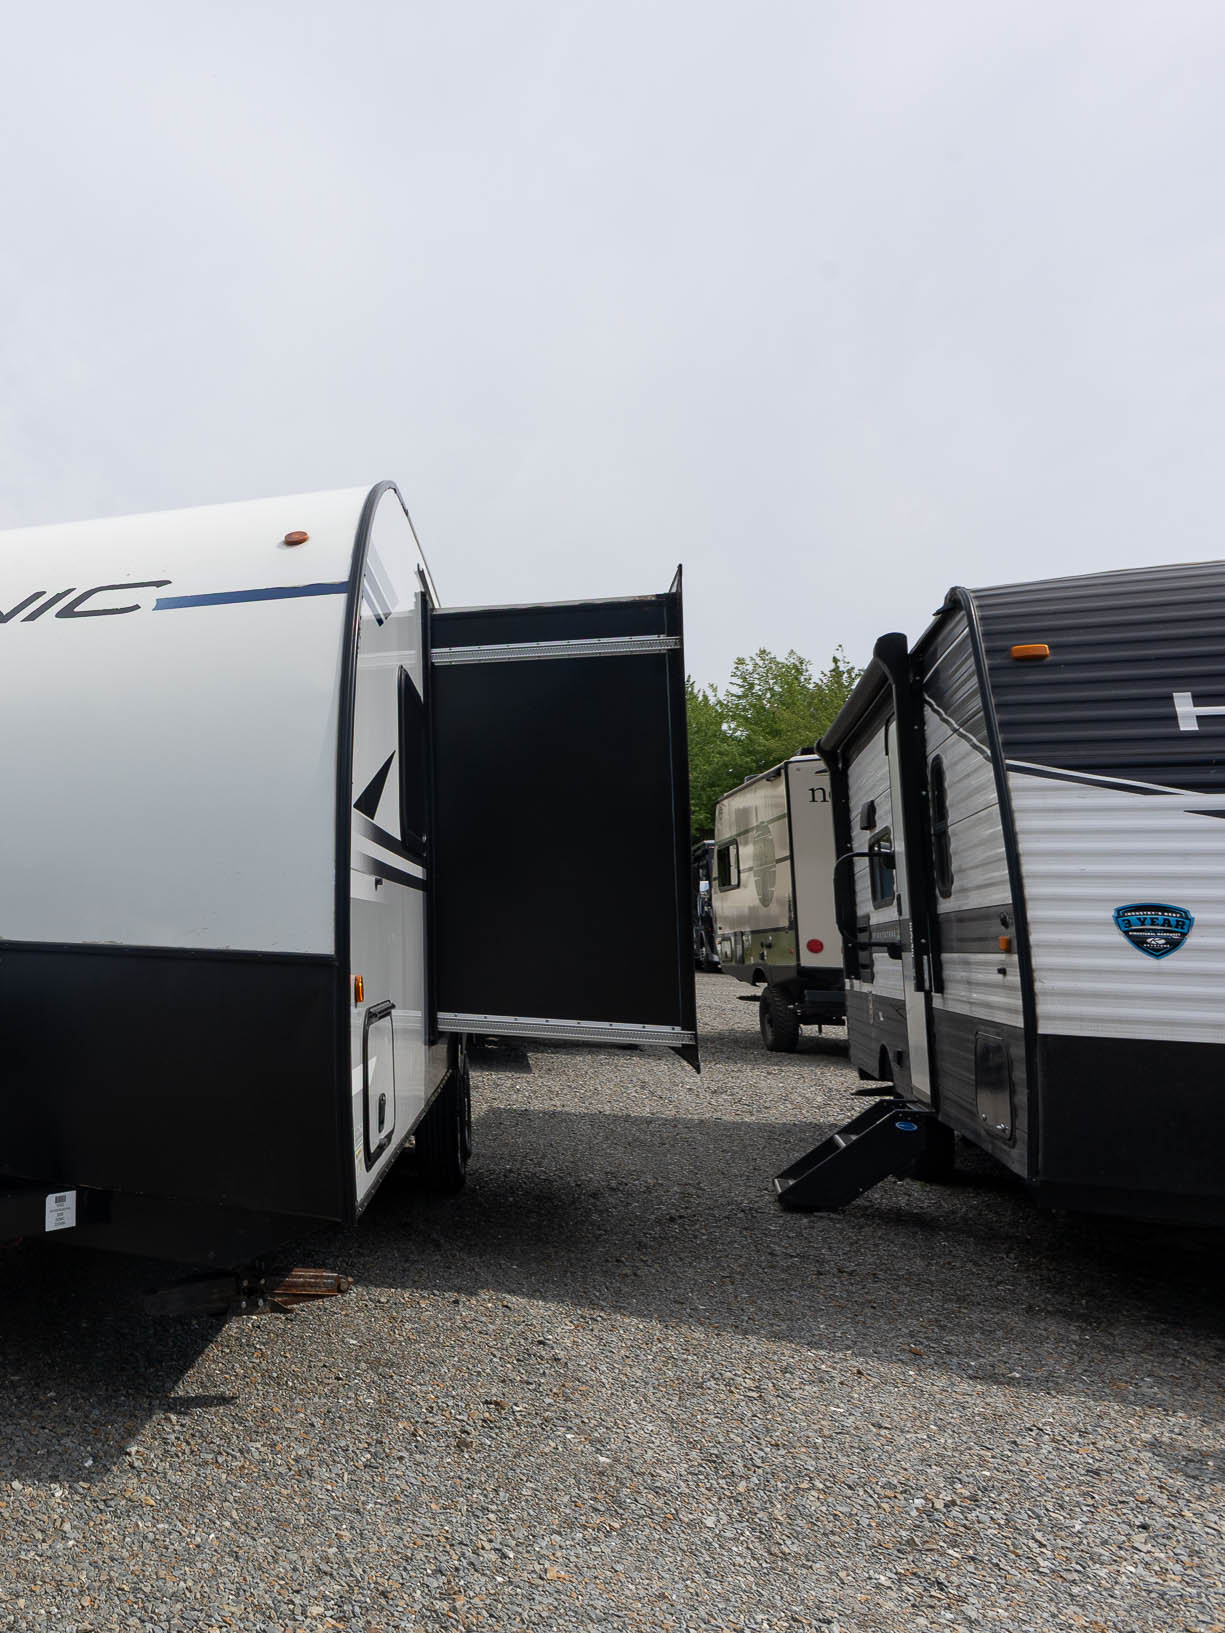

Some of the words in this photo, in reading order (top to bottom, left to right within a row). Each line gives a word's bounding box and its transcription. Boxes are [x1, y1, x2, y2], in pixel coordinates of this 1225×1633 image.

[808, 787, 832, 803] n
[1121, 918, 1132, 929] 3
[1136, 916, 1186, 930] YEAR
